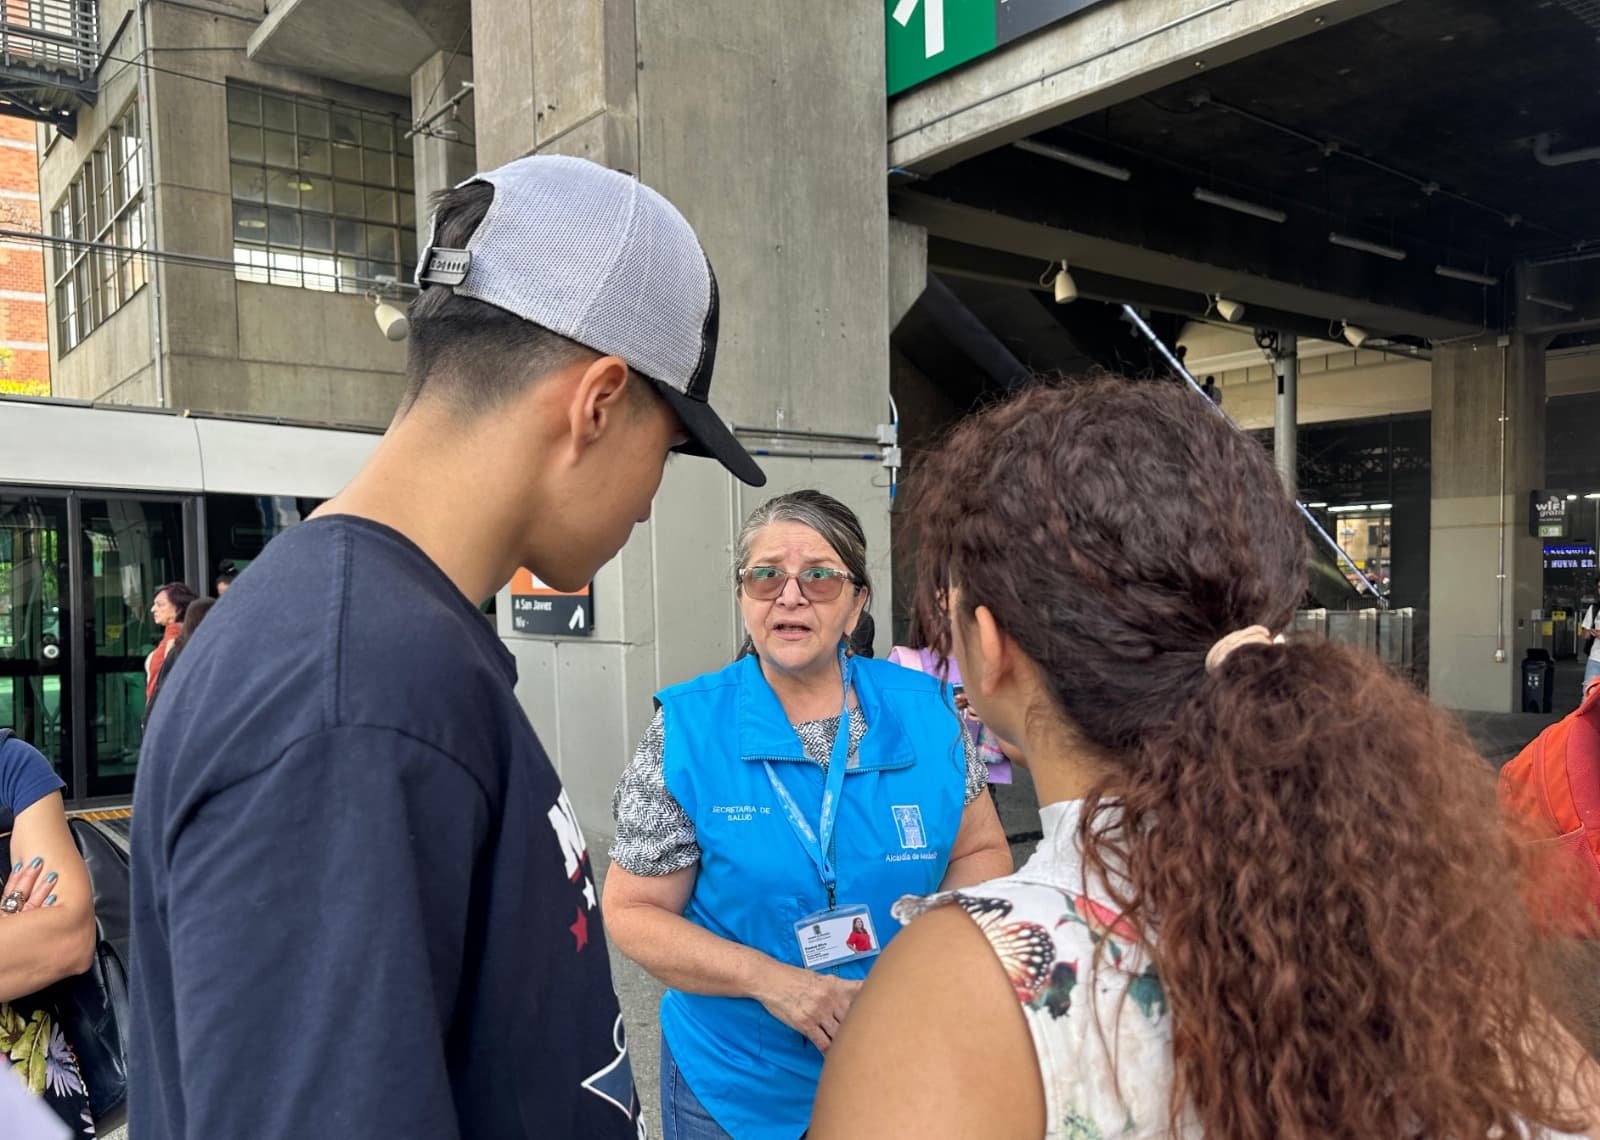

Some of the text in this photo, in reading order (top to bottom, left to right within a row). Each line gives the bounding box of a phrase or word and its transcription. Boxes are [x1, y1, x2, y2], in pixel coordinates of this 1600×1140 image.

[521, 598, 532, 611] San
[533, 600, 552, 611] Javier
[712, 805, 757, 814] SECRETARIA
